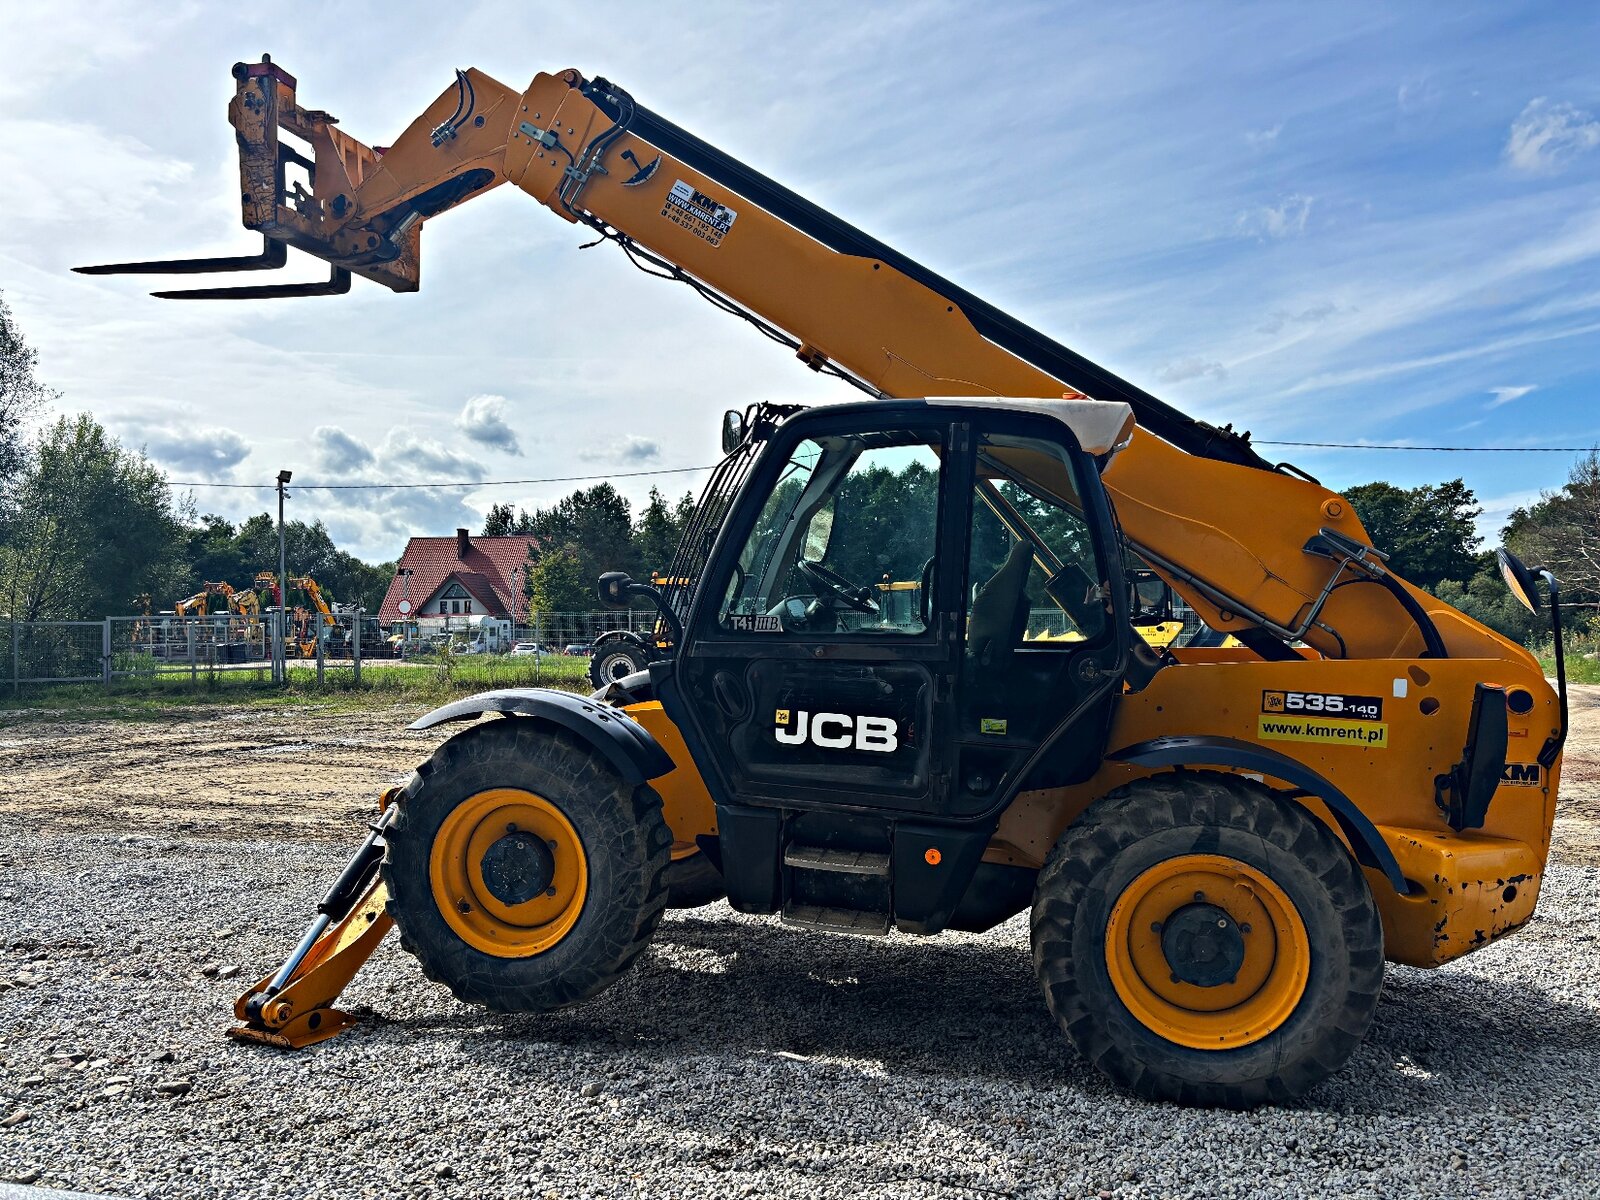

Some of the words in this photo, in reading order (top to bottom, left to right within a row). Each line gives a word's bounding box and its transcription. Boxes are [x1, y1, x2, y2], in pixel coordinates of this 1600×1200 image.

[668, 193, 728, 234] WWW.KMRENT.PL
[691, 190, 719, 214] KM
[679, 220, 693, 231] 537
[692, 227, 706, 239] 003
[683, 212, 696, 223] 661
[697, 219, 709, 232] 195
[1286, 692, 1378, 715] 535-140
[775, 710, 898, 753] JCB
[1262, 722, 1384, 744] www.kmrent.pl
